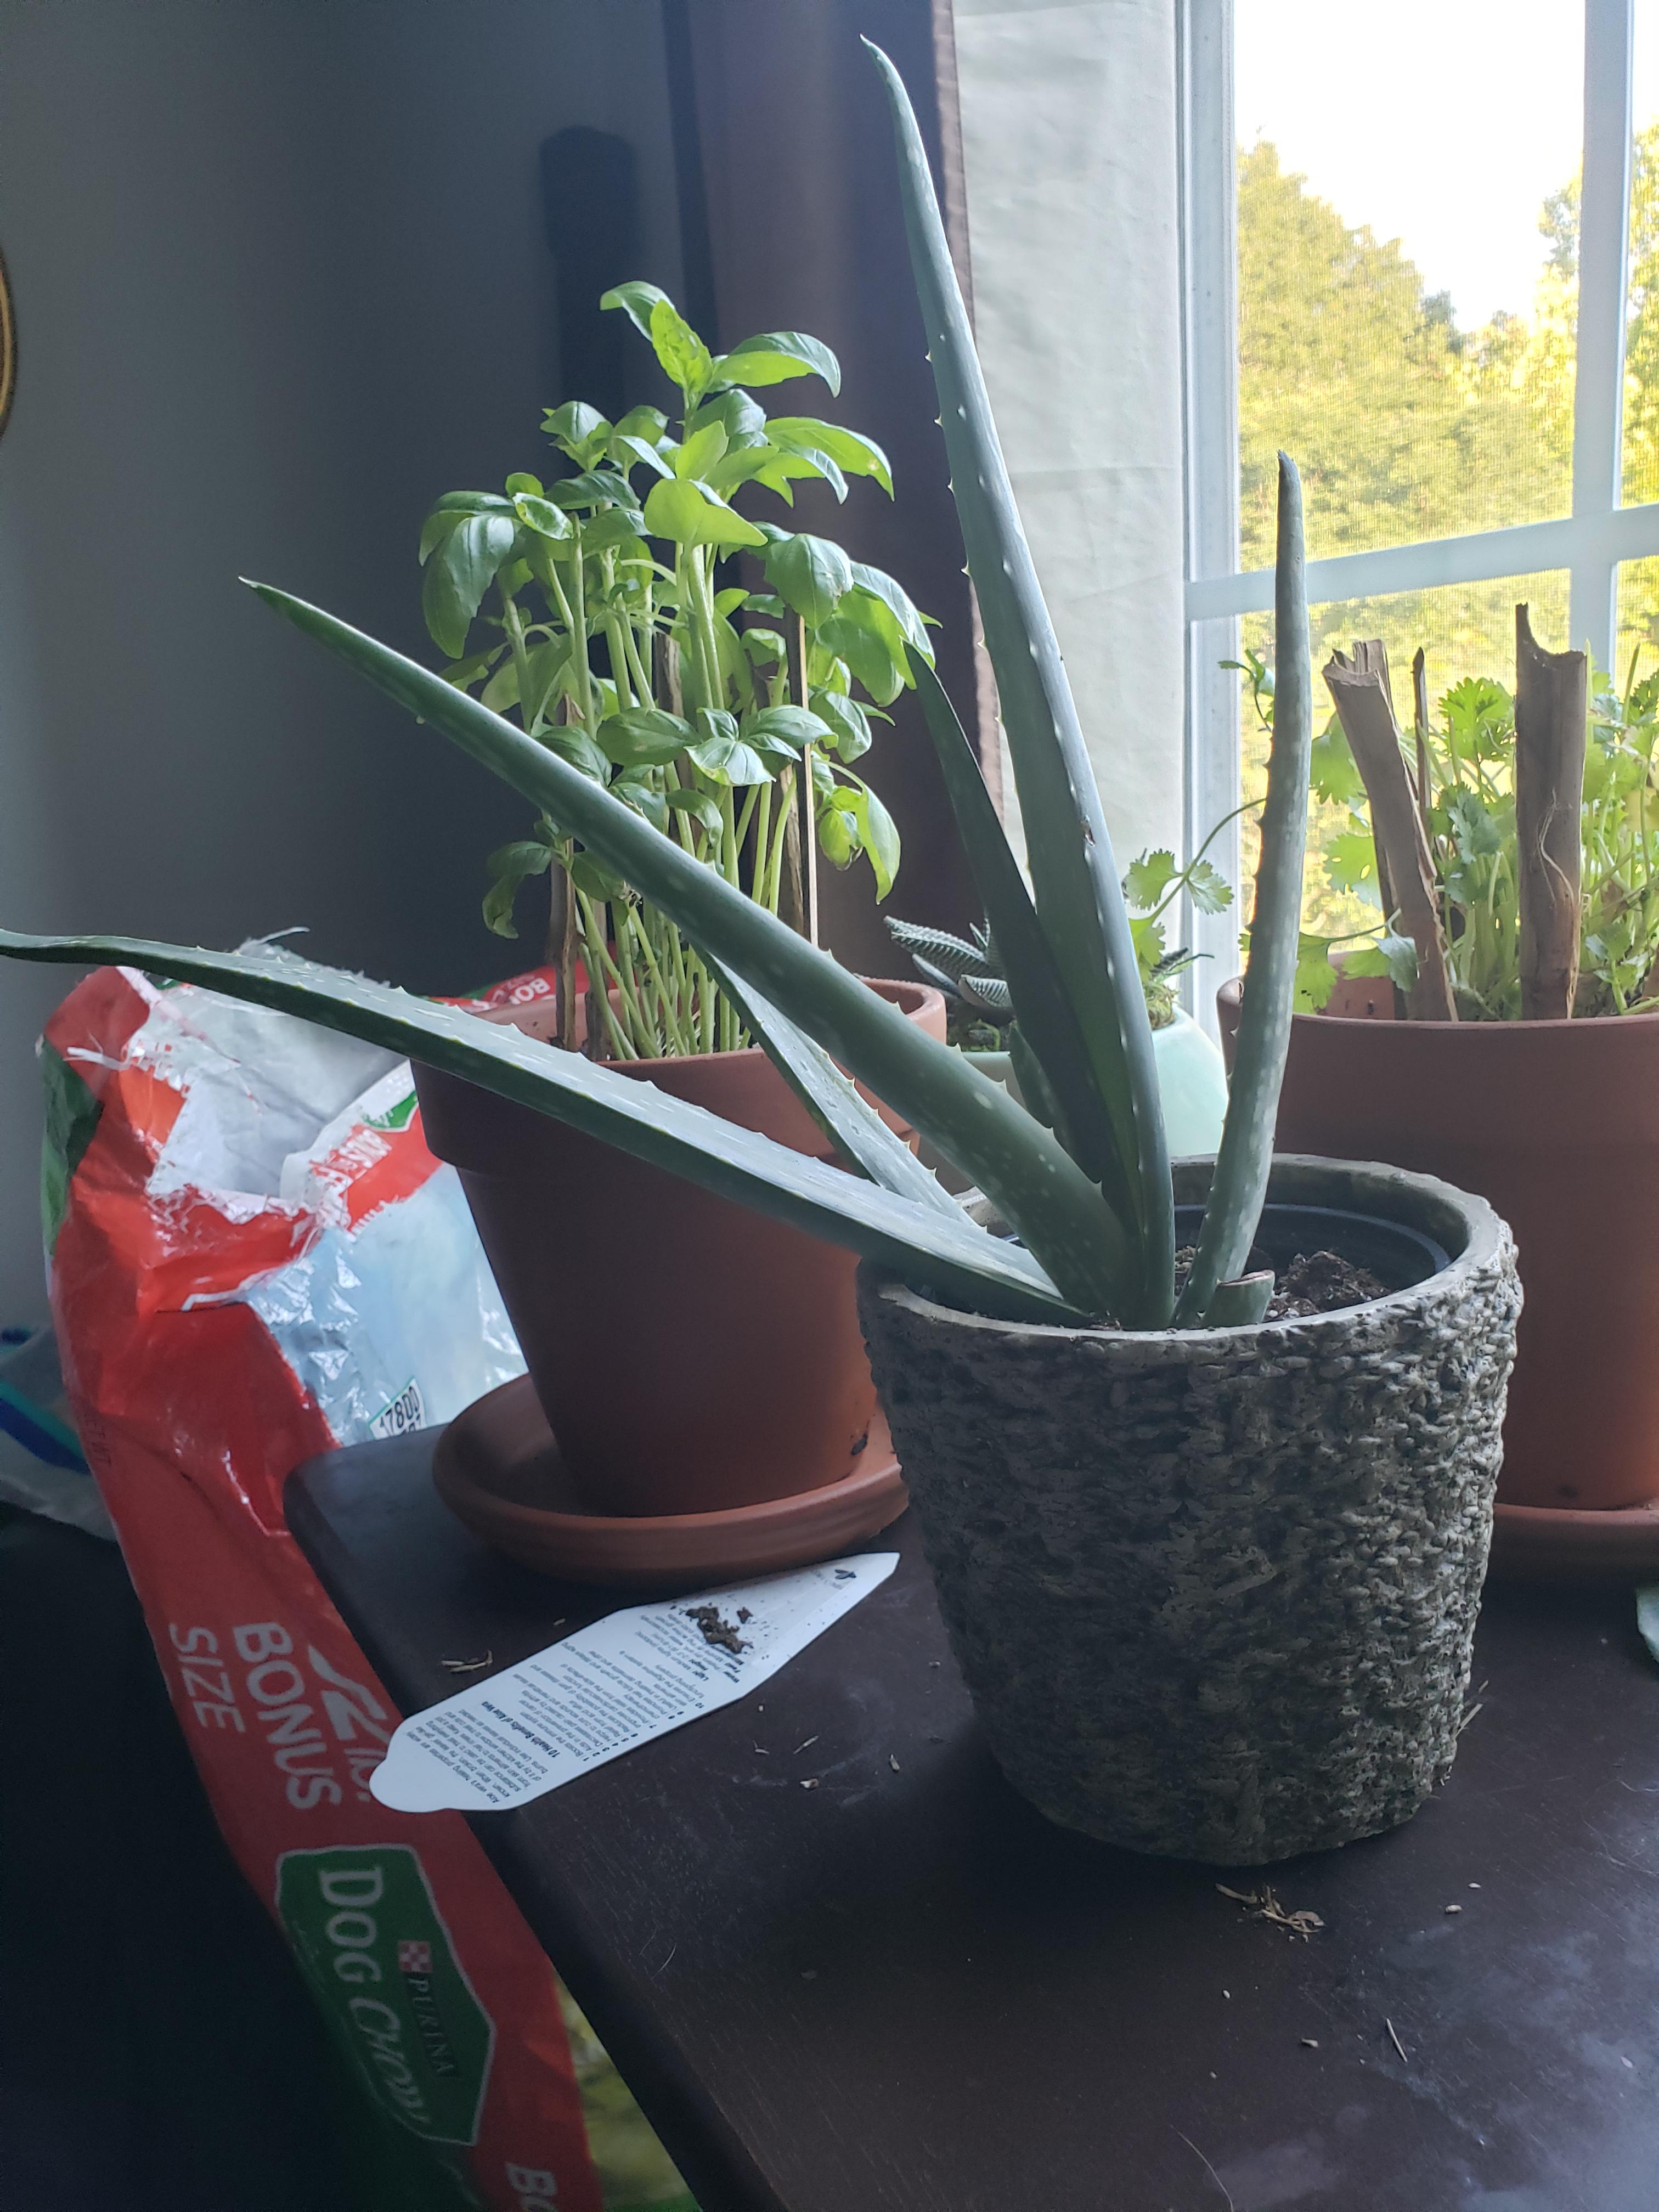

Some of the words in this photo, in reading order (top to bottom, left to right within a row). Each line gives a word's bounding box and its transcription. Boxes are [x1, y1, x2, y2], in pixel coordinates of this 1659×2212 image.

[168, 1623, 246, 1733] SIZE
[233, 1621, 342, 1809] BONUS
[492, 1709, 507, 1719] Aloe
[510, 1721, 535, 1739] Benefits
[530, 1736, 553, 1752] Health
[486, 1792, 500, 1803] Aloe
[319, 1866, 383, 1982] DOG
[408, 1976, 455, 2075] PURINA
